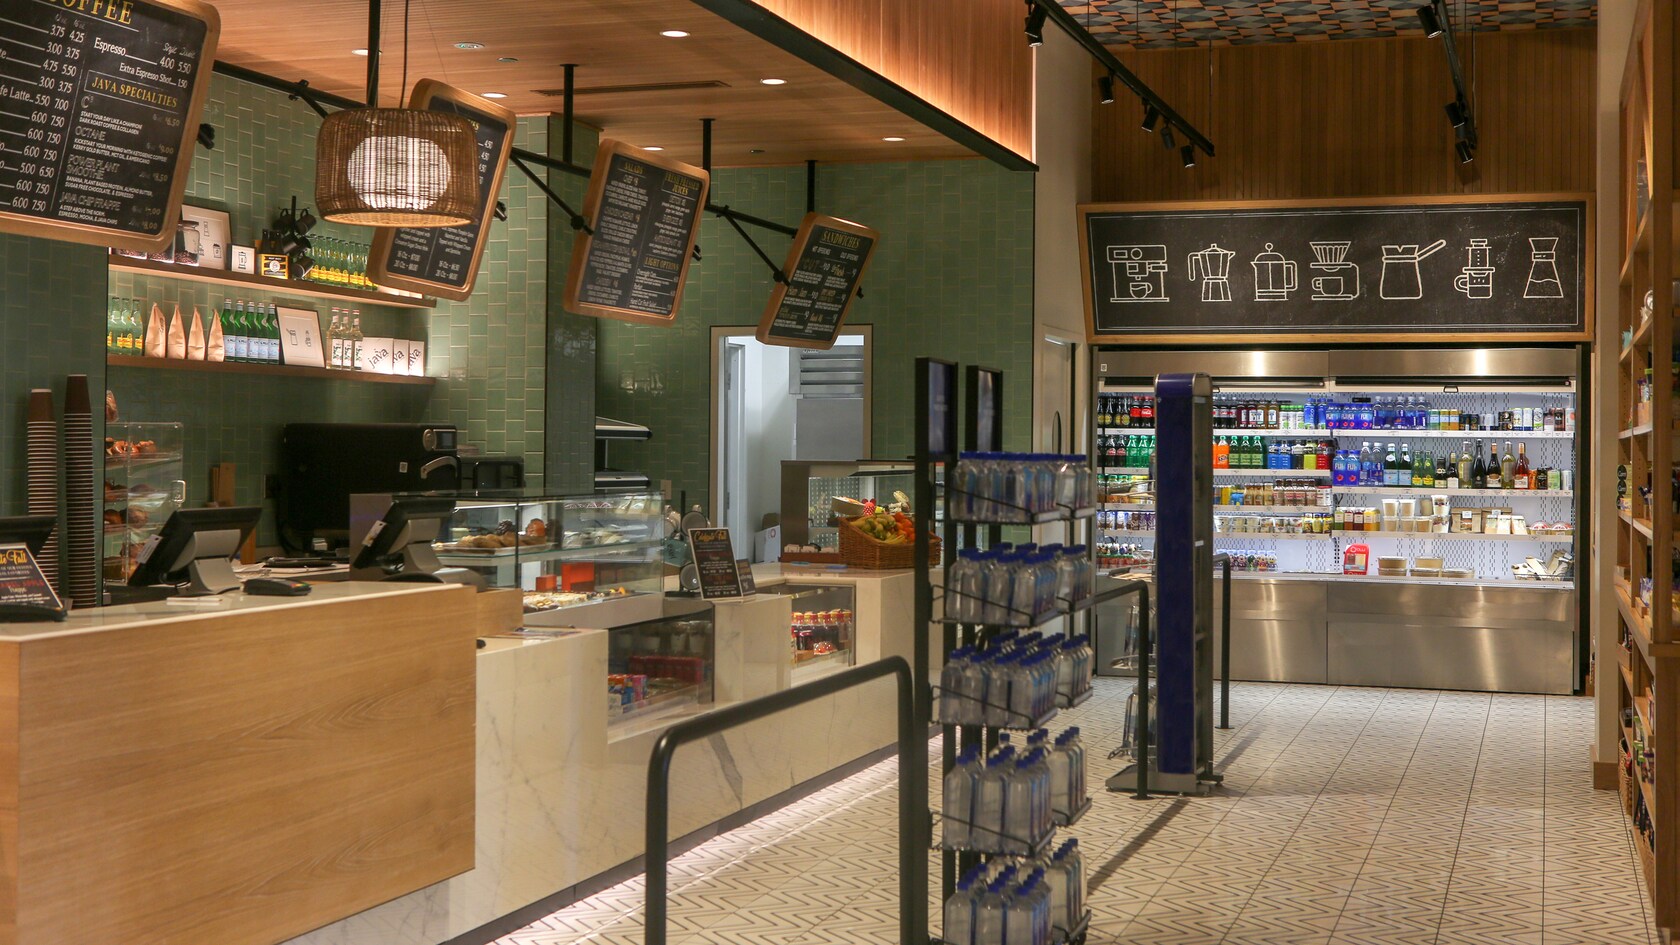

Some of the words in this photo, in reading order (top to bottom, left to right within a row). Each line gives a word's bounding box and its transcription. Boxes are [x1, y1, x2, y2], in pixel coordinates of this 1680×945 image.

[51, 0, 133, 24] FFEE
[50, 24, 65, 37] 3.75
[70, 30, 85, 42] 4.25
[46, 42, 62, 55] 3.00
[65, 47, 80, 60] 3.75
[94, 37, 126, 56] Espresso
[160, 56, 175, 70] 4.00
[177, 62, 191, 74] 5.50
[43, 59, 58, 72] 4.75
[62, 64, 76, 76] 5.50
[119, 62, 134, 74] Extra
[135, 67, 159, 82] Espresso
[160, 74, 171, 84] Shot
[177, 78, 188, 89] 1.50
[39, 76, 54, 89] 3.00
[58, 81, 72, 93] 3.75
[92, 77, 116, 93] JAVA
[119, 84, 177, 108] SPECIALTIES
[10, 87, 30, 102] Latte
[35, 94, 50, 106] 5.50
[54, 98, 69, 110] 7.00
[32, 111, 47, 124] 6.00
[50, 115, 65, 127] 7.50
[28, 128, 43, 141] 6.00
[47, 132, 61, 144] 7.50
[76, 126, 106, 141] OCTANE
[24, 145, 40, 158] 6.00
[43, 149, 57, 161] 7.50
[20, 163, 36, 175] 5.00
[39, 166, 54, 178] 6.50
[16, 180, 32, 192] 6.00
[35, 183, 50, 195] 7.50
[12, 197, 28, 208] 6.00
[32, 200, 46, 212] 7.50
[822, 230, 860, 249] SANDWICHES
[368, 348, 388, 369] java
